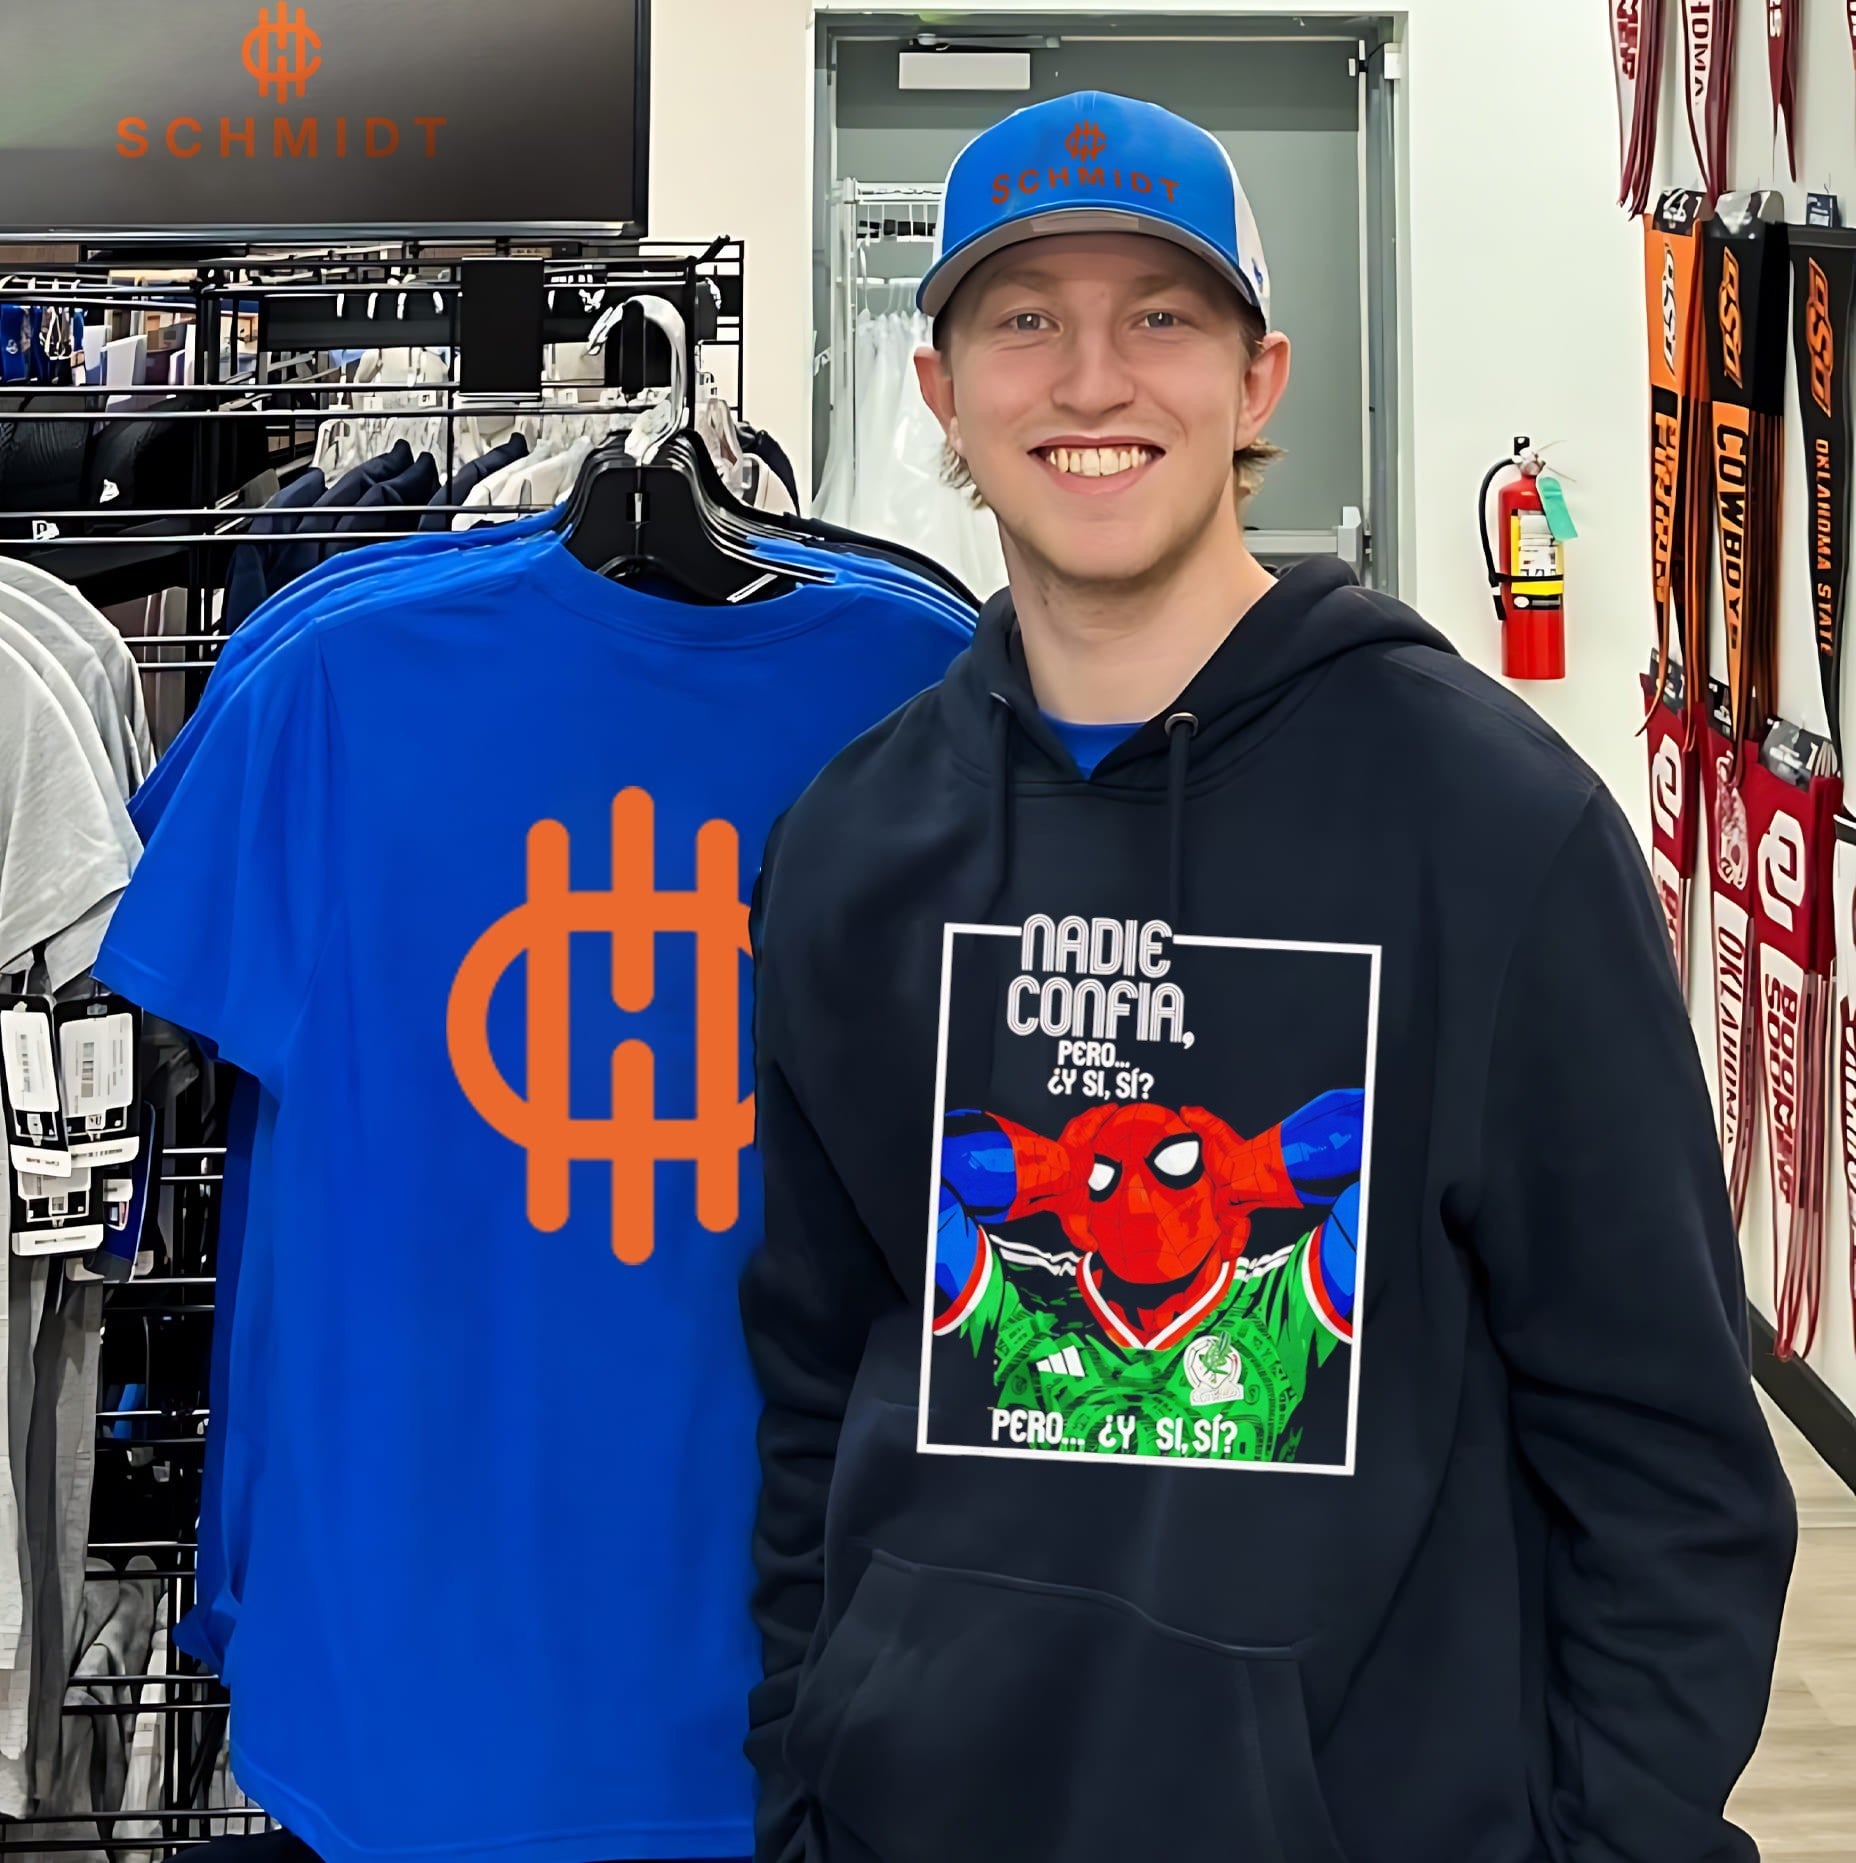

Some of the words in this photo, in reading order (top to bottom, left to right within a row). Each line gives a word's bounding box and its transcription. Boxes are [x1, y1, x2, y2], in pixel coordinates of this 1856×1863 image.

[115, 116, 447, 158] SCHMIDT
[991, 166, 1179, 205] SCHMIDT
[1020, 913, 1173, 978] NADIE
[1006, 975, 1195, 1050] CONFIA,
[1057, 1040, 1131, 1068] PERO...
[1047, 1067, 1078, 1095] ¿Y
[1082, 1069, 1111, 1100] SI,
[1115, 1067, 1155, 1100] SÍ?
[991, 1408, 1086, 1446] PERO...
[1098, 1414, 1136, 1449] ¿Y
